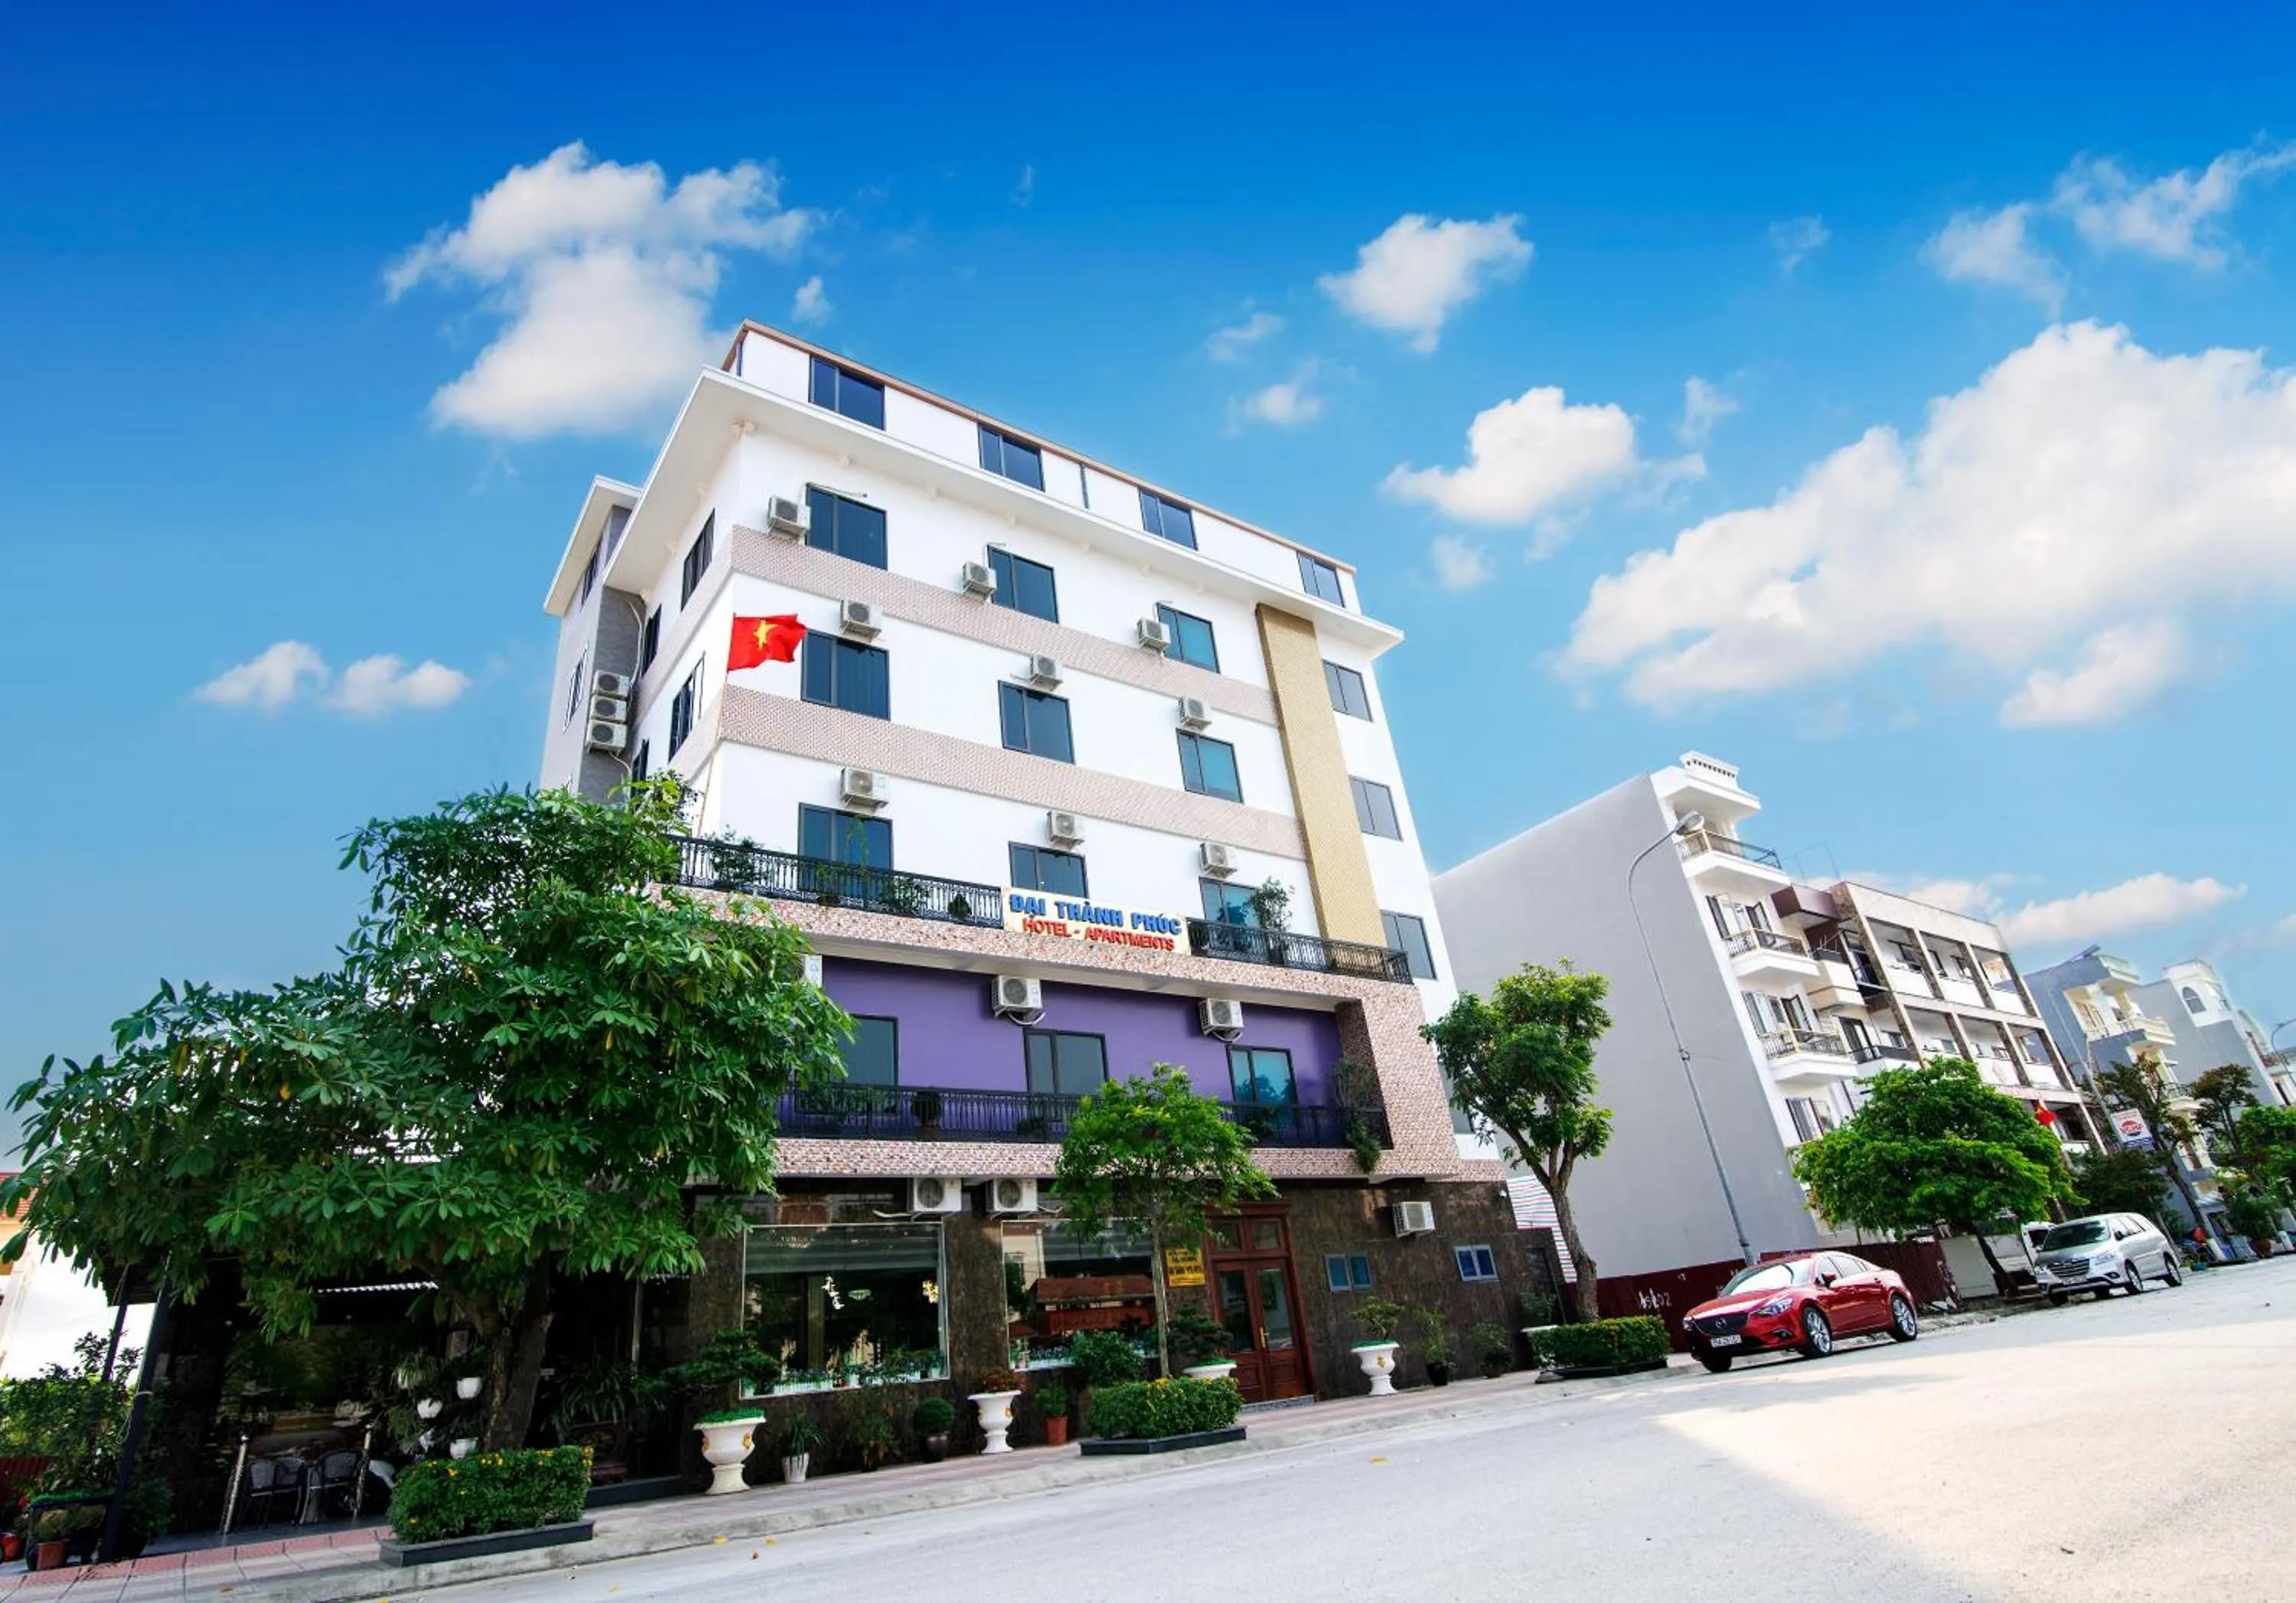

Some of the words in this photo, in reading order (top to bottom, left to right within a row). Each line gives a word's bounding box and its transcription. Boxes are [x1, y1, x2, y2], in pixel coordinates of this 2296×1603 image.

[1009, 894, 1046, 918] ĐẠI
[1130, 912, 1182, 935] PHÚC
[1022, 918, 1071, 937] HOTEL
[1084, 927, 1175, 951] APARTMENTS
